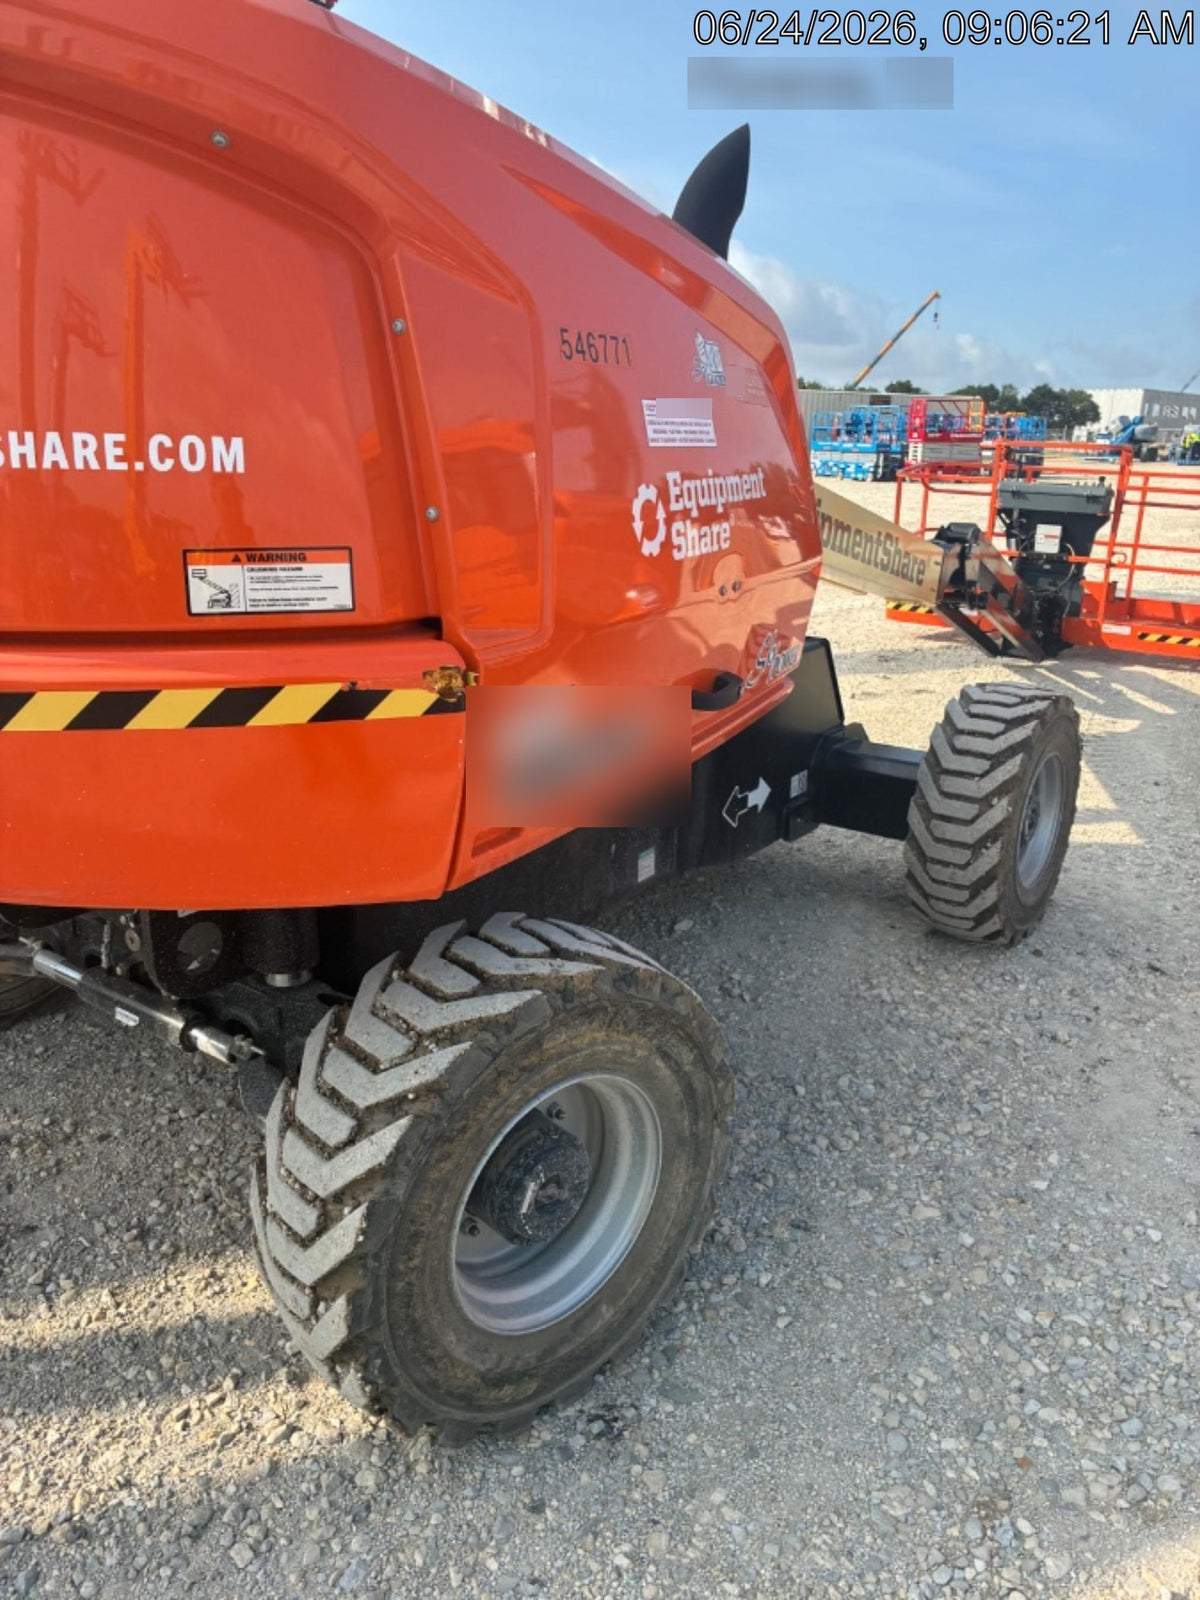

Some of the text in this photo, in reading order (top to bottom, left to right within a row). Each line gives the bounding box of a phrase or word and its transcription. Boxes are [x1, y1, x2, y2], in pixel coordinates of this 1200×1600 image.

[559, 328, 632, 367] 546771
[666, 468, 766, 518] Equipment
[246, 552, 307, 563] WARNING
[671, 519, 731, 561] Share
